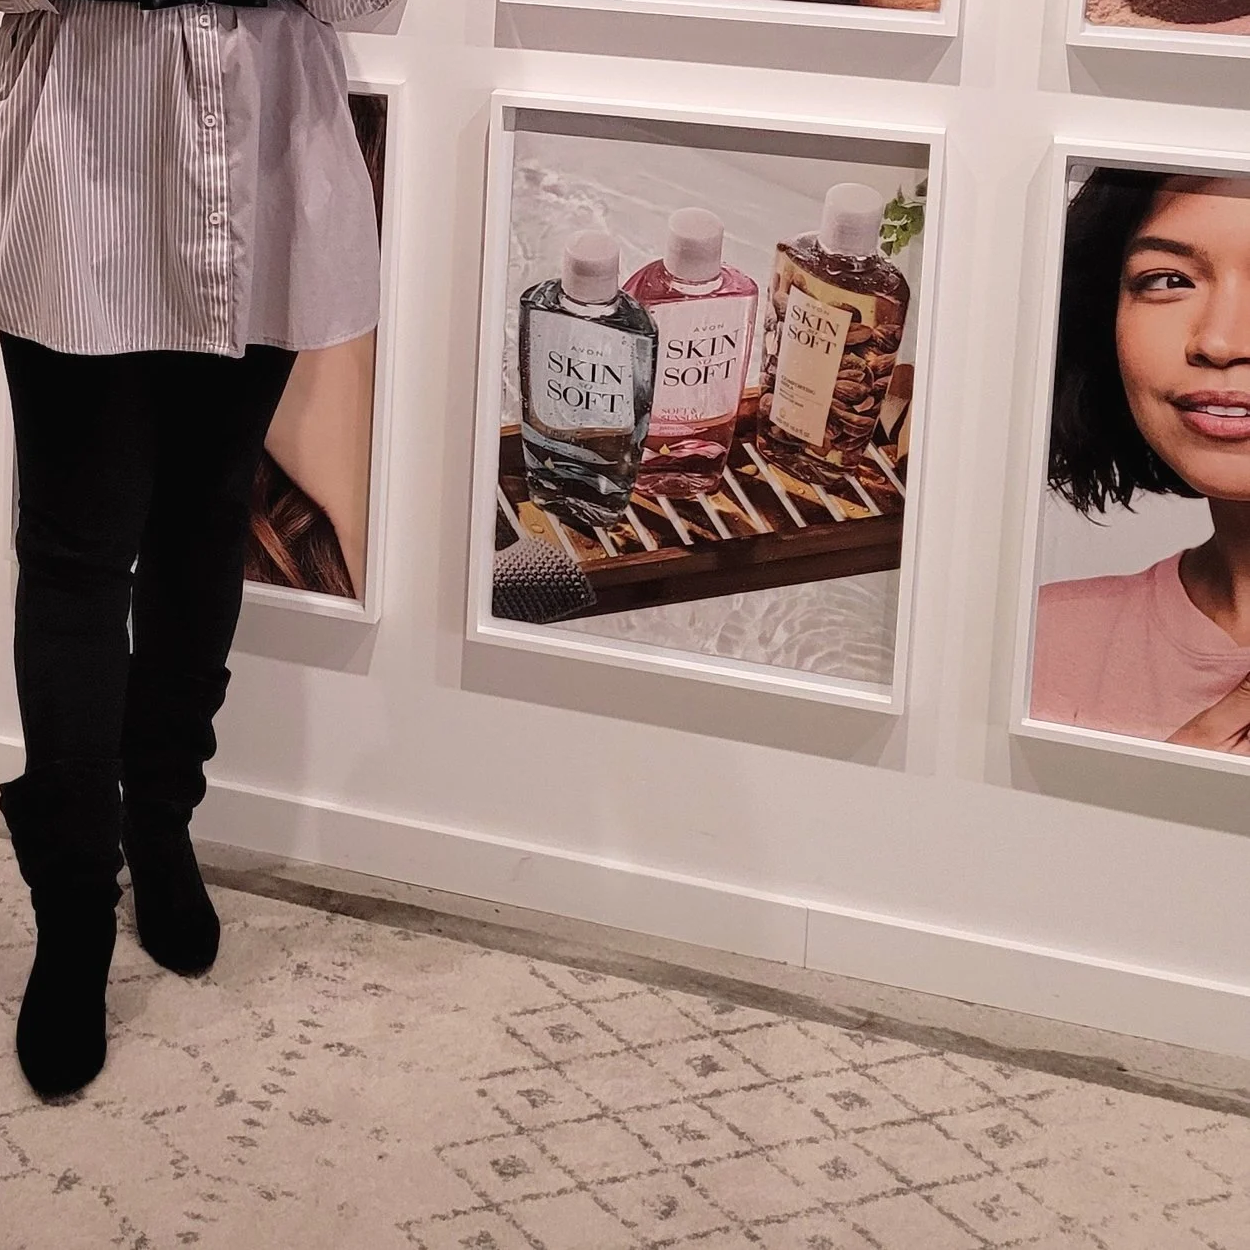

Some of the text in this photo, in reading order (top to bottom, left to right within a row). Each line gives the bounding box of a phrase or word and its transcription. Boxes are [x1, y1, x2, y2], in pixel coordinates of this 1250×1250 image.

[693, 324, 724, 333] AVON
[790, 304, 840, 337] SKIN
[570, 345, 604, 357] AVON
[666, 329, 739, 360] SKIN
[787, 323, 837, 355] SOFT
[547, 350, 625, 385] SKIN
[662, 358, 737, 387] SOFT
[546, 378, 624, 413] SOFT
[661, 407, 690, 416] SOFT
